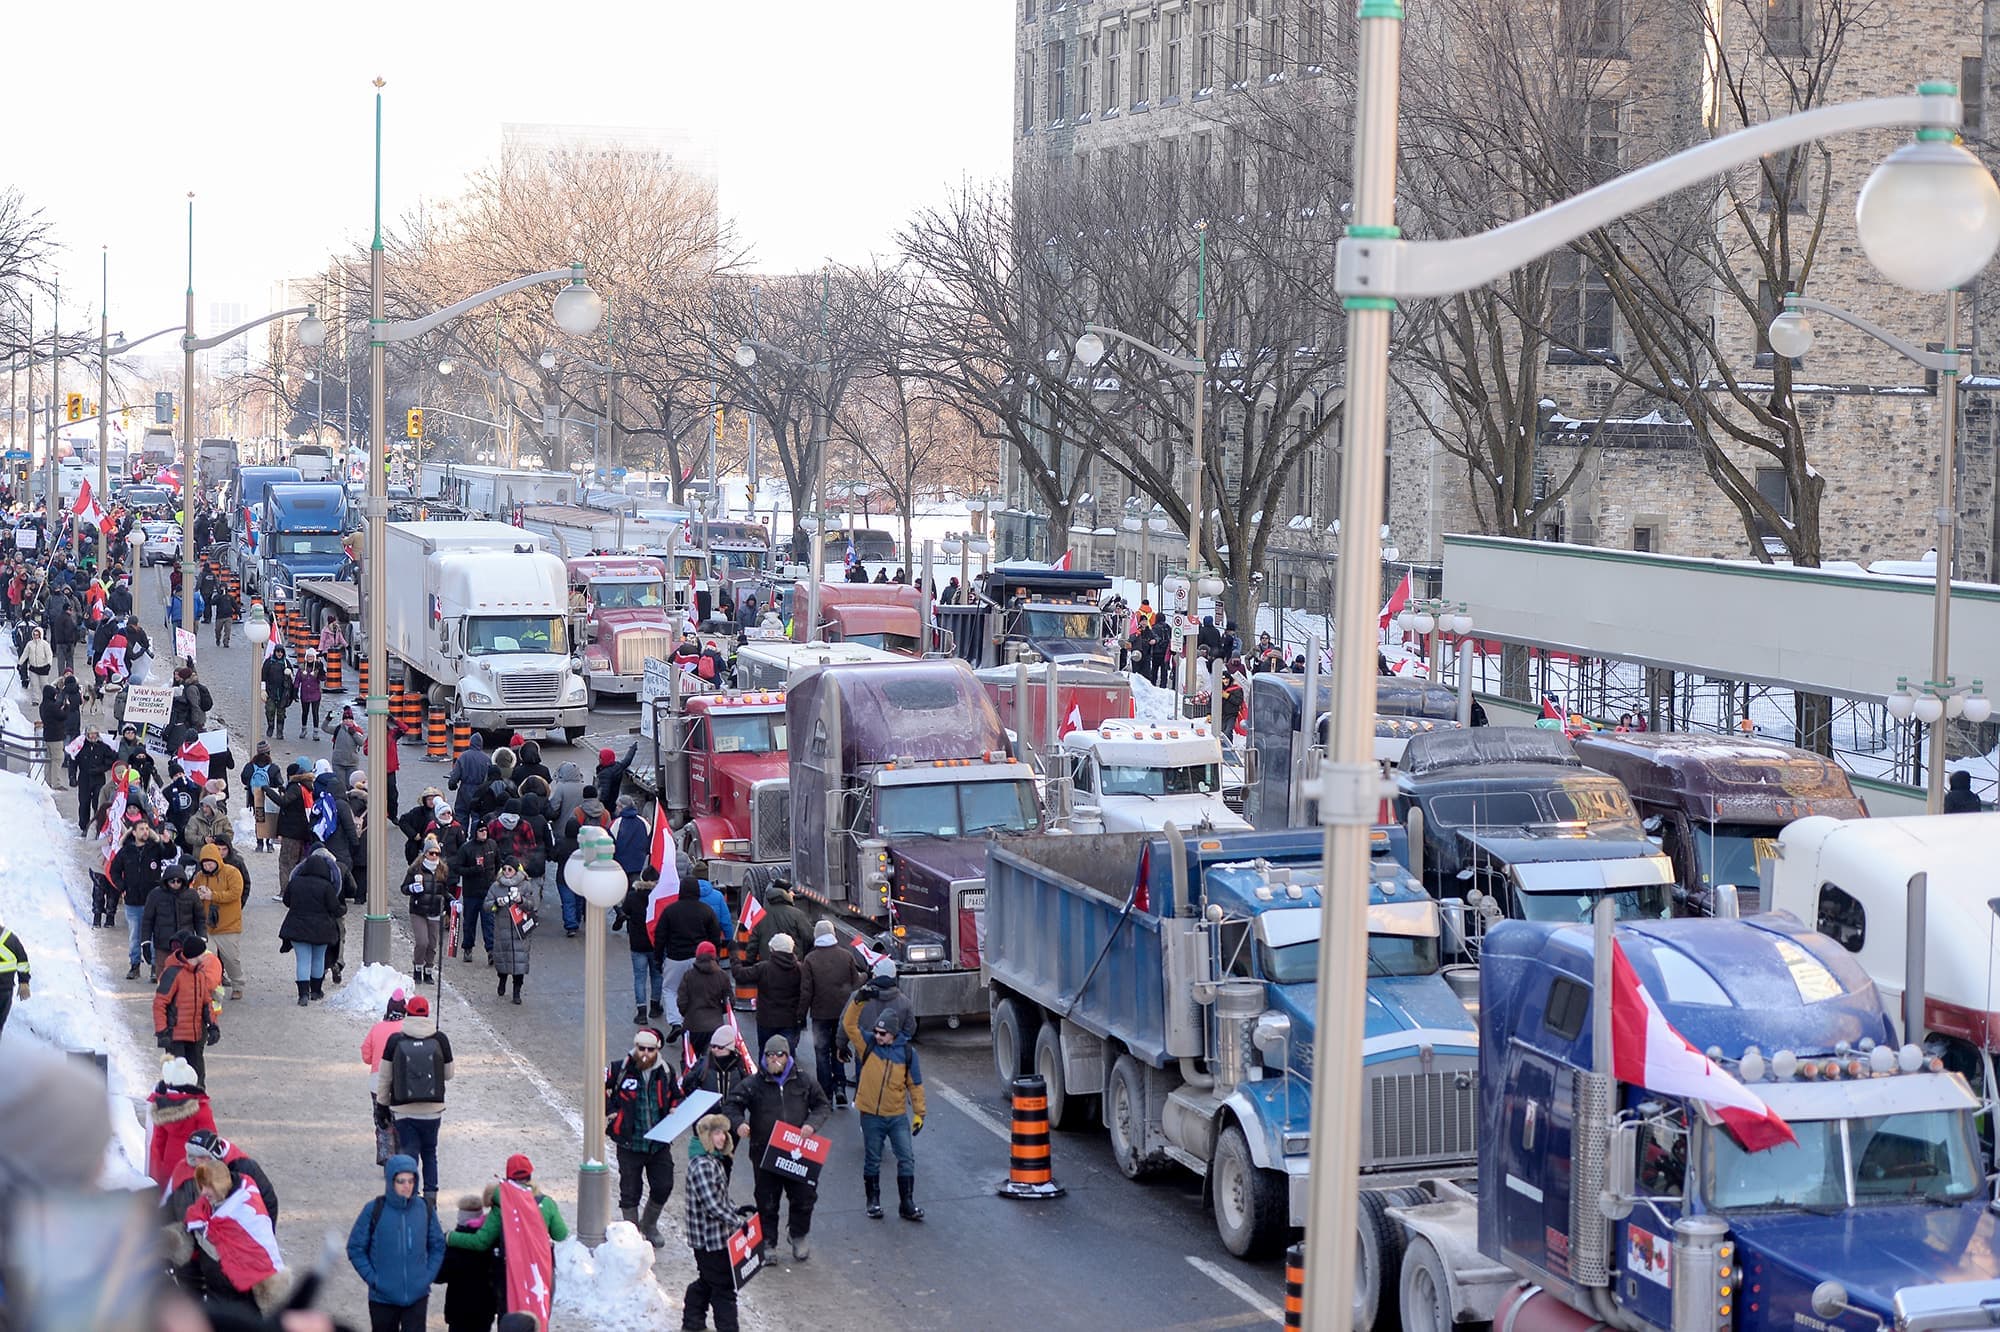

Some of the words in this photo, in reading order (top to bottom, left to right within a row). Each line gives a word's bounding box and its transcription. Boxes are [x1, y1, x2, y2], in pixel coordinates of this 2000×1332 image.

[783, 1130, 803, 1147] FIGHT
[803, 1138, 819, 1152] FOR
[775, 1156, 808, 1177] FREEDOM
